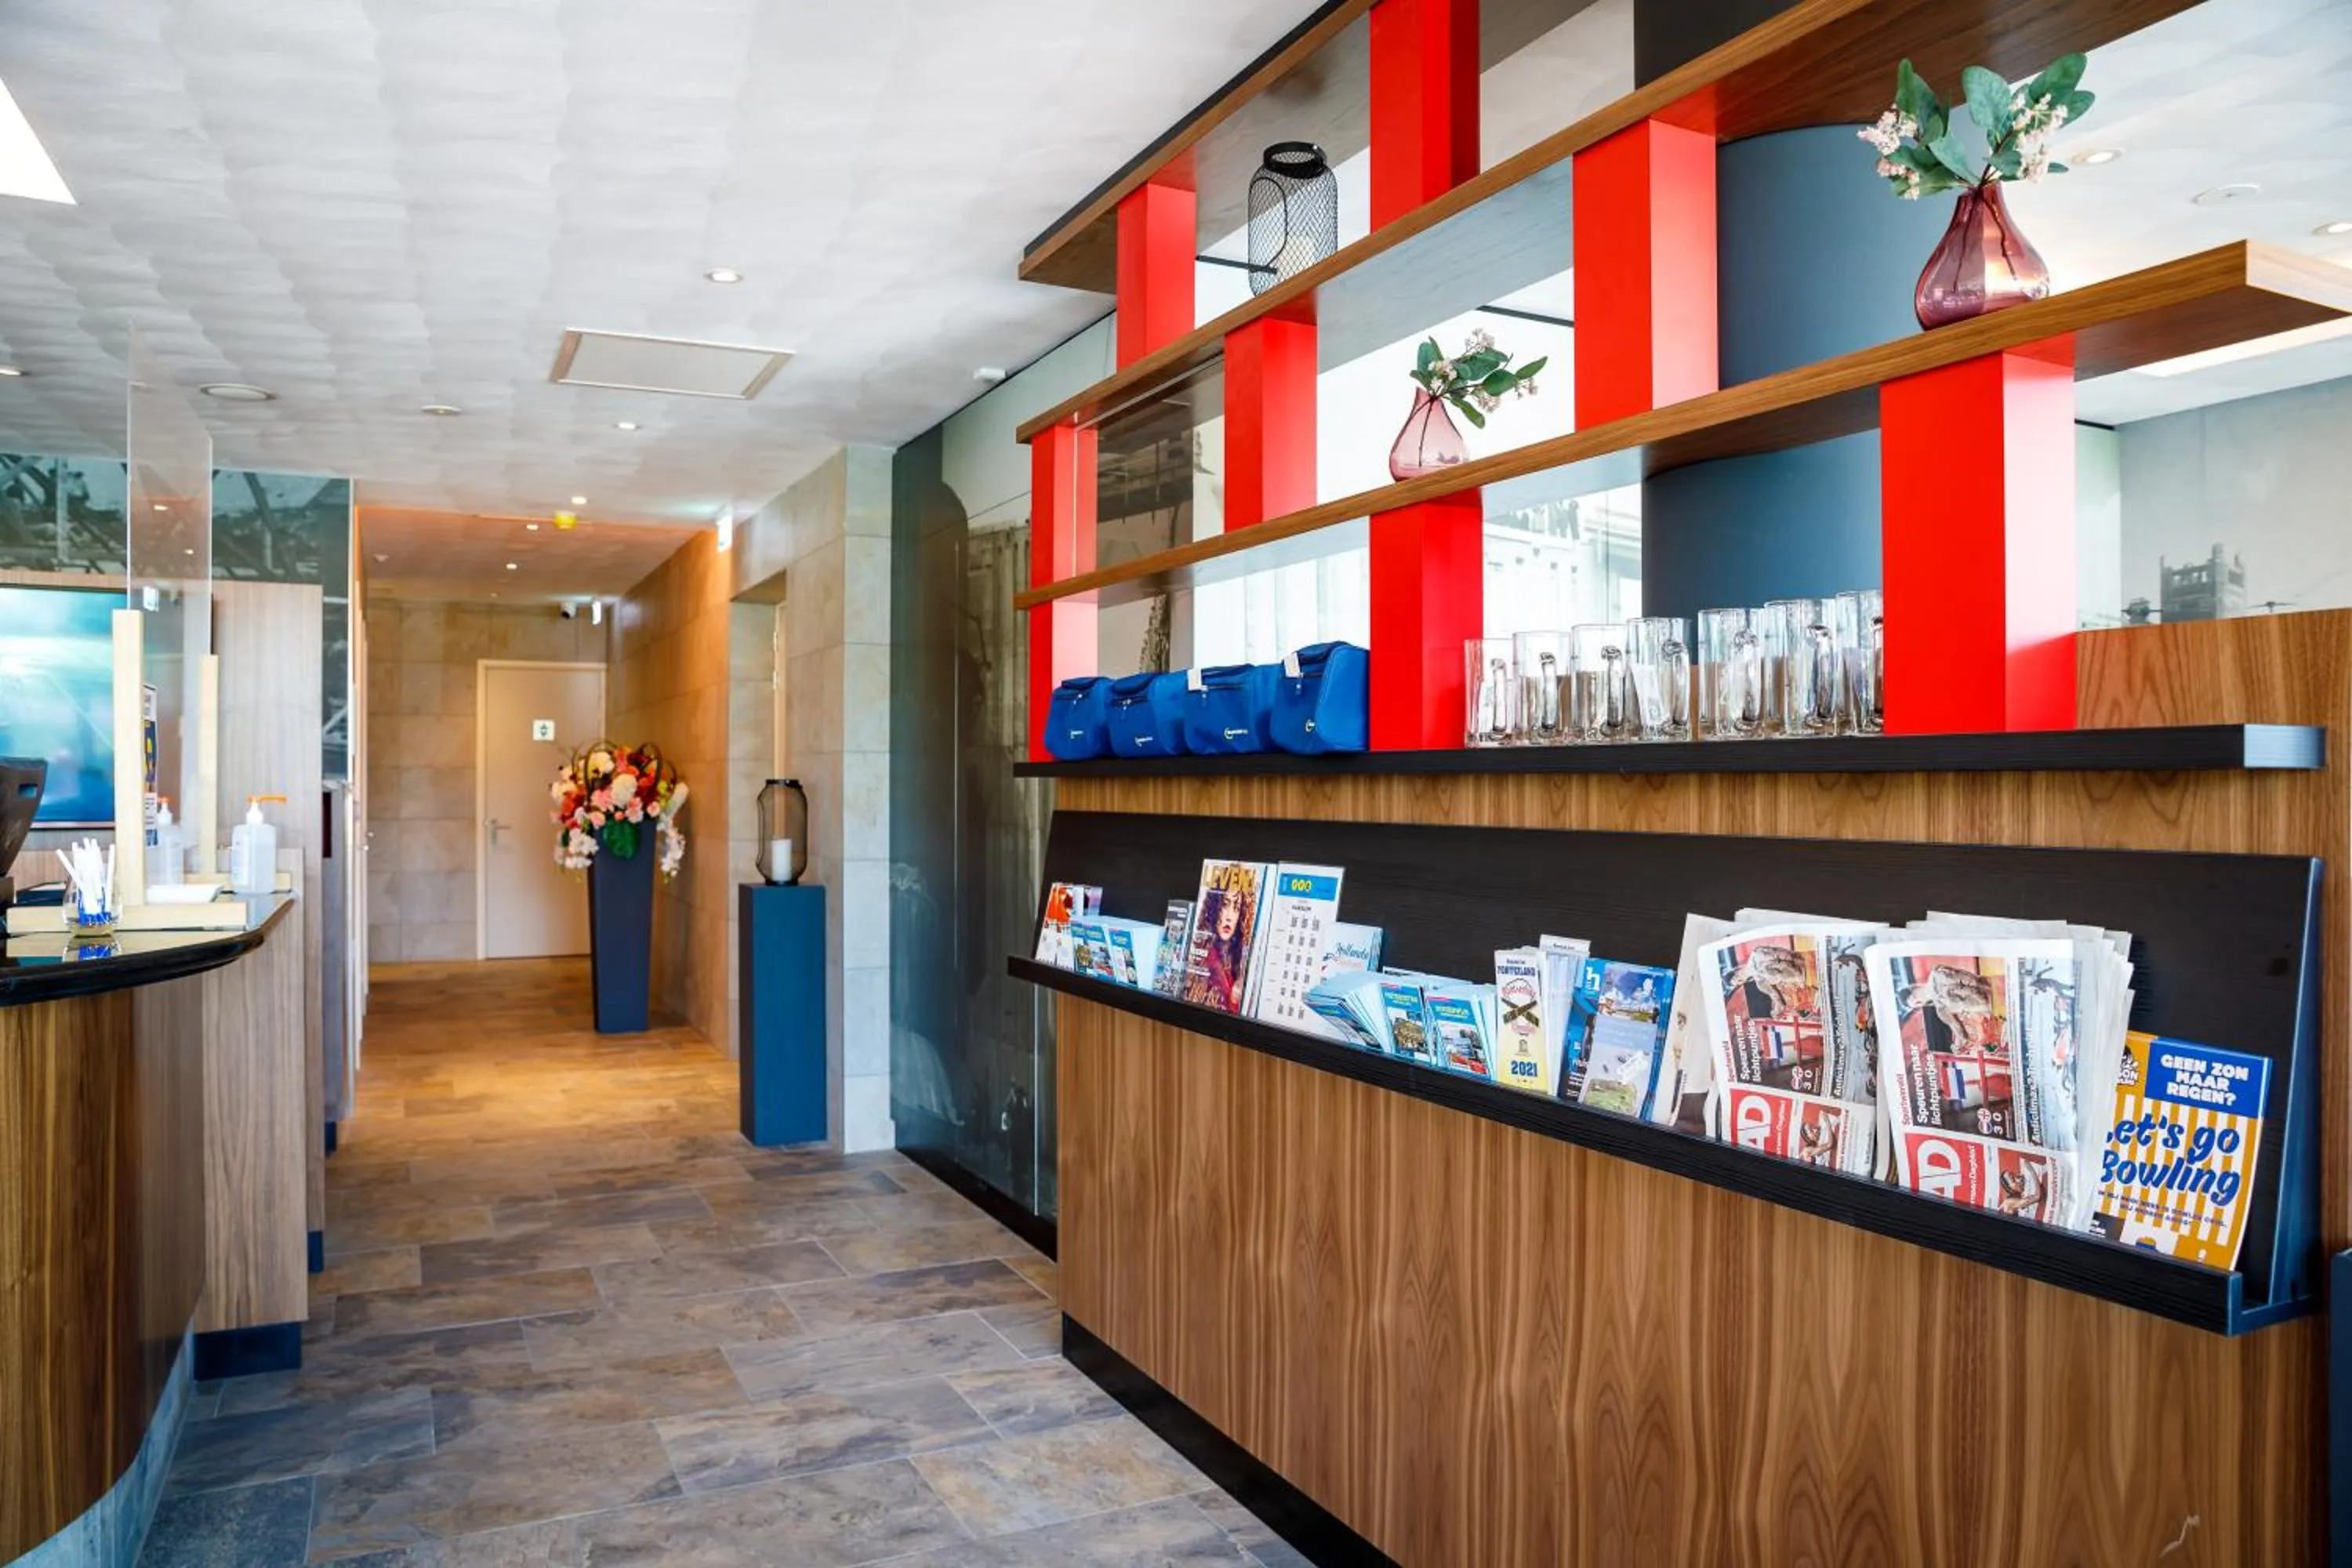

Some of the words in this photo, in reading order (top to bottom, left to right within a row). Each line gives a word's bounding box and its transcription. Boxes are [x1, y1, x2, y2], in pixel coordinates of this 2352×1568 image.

[1733, 1014, 1743, 1036] naar
[1511, 1060, 1538, 1078] 2021
[1737, 1037, 1751, 1081] Speuren
[1747, 1019, 1762, 1083] lichtpuntjes
[1911, 1044, 1920, 1071] naar
[2161, 1054, 2207, 1073] GEEN
[2211, 1062, 2249, 1080] ZON
[1914, 1072, 1929, 1124] Speuren
[1926, 1053, 1942, 1126] lichtpuntjes
[2166, 1081, 2237, 1106] REGEN?
[2176, 1070, 2230, 1091] MAAR
[1738, 1094, 1772, 1151] AD
[2106, 1112, 2185, 1149] et's
[2187, 1126, 2240, 1165] go
[1918, 1140, 1962, 1199] AD
[2100, 1149, 2241, 1206] Bowling
